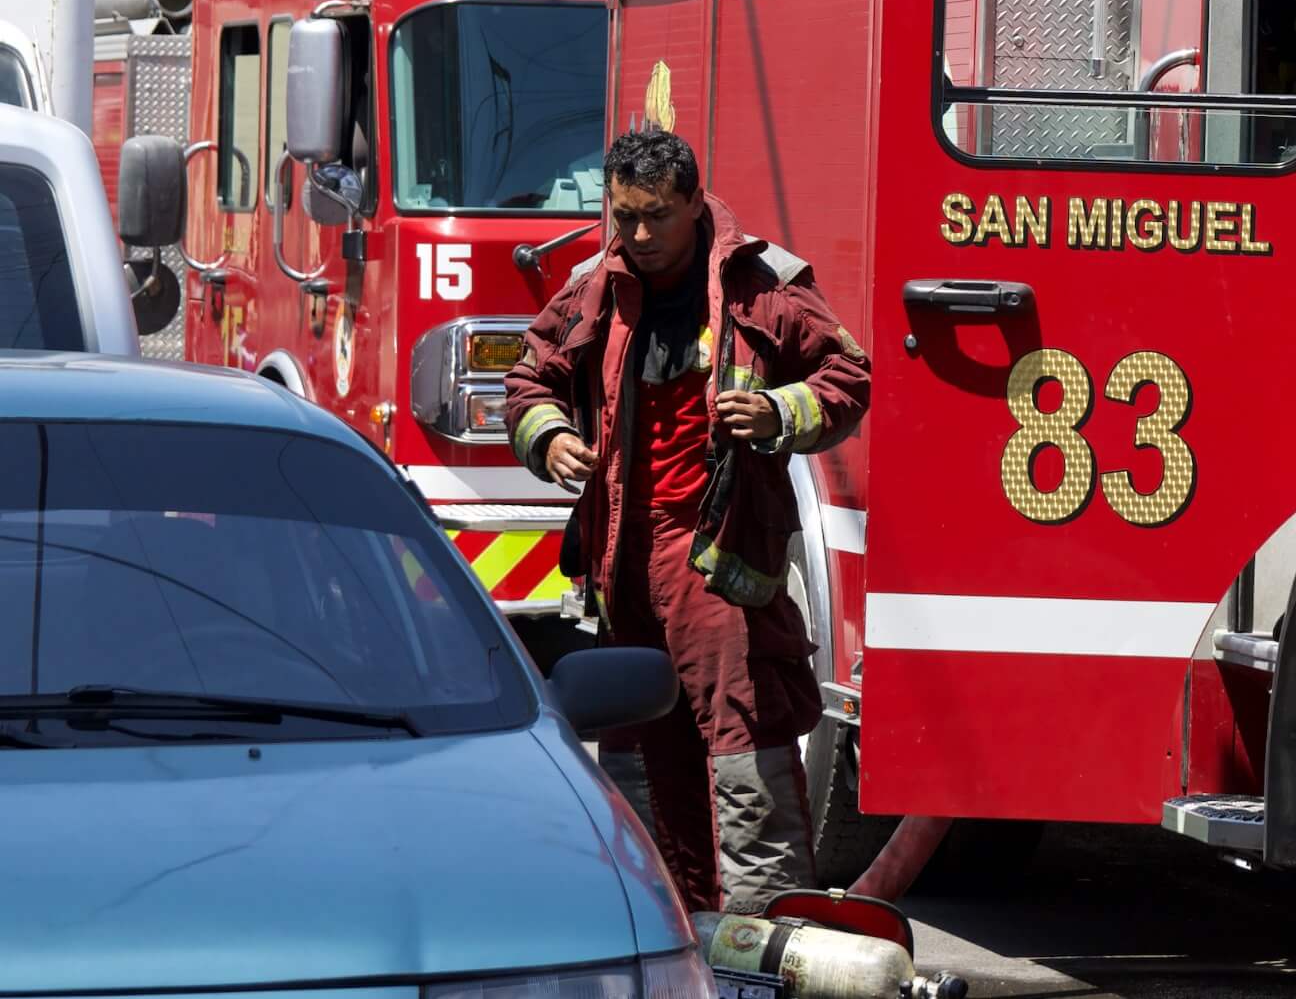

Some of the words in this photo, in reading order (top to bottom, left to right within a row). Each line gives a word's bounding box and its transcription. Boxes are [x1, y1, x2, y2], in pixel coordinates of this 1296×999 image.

[940, 192, 1050, 248] SAN
[1066, 196, 1273, 256] MIGUEL
[415, 242, 473, 301] 15
[1000, 348, 1197, 528] 83
